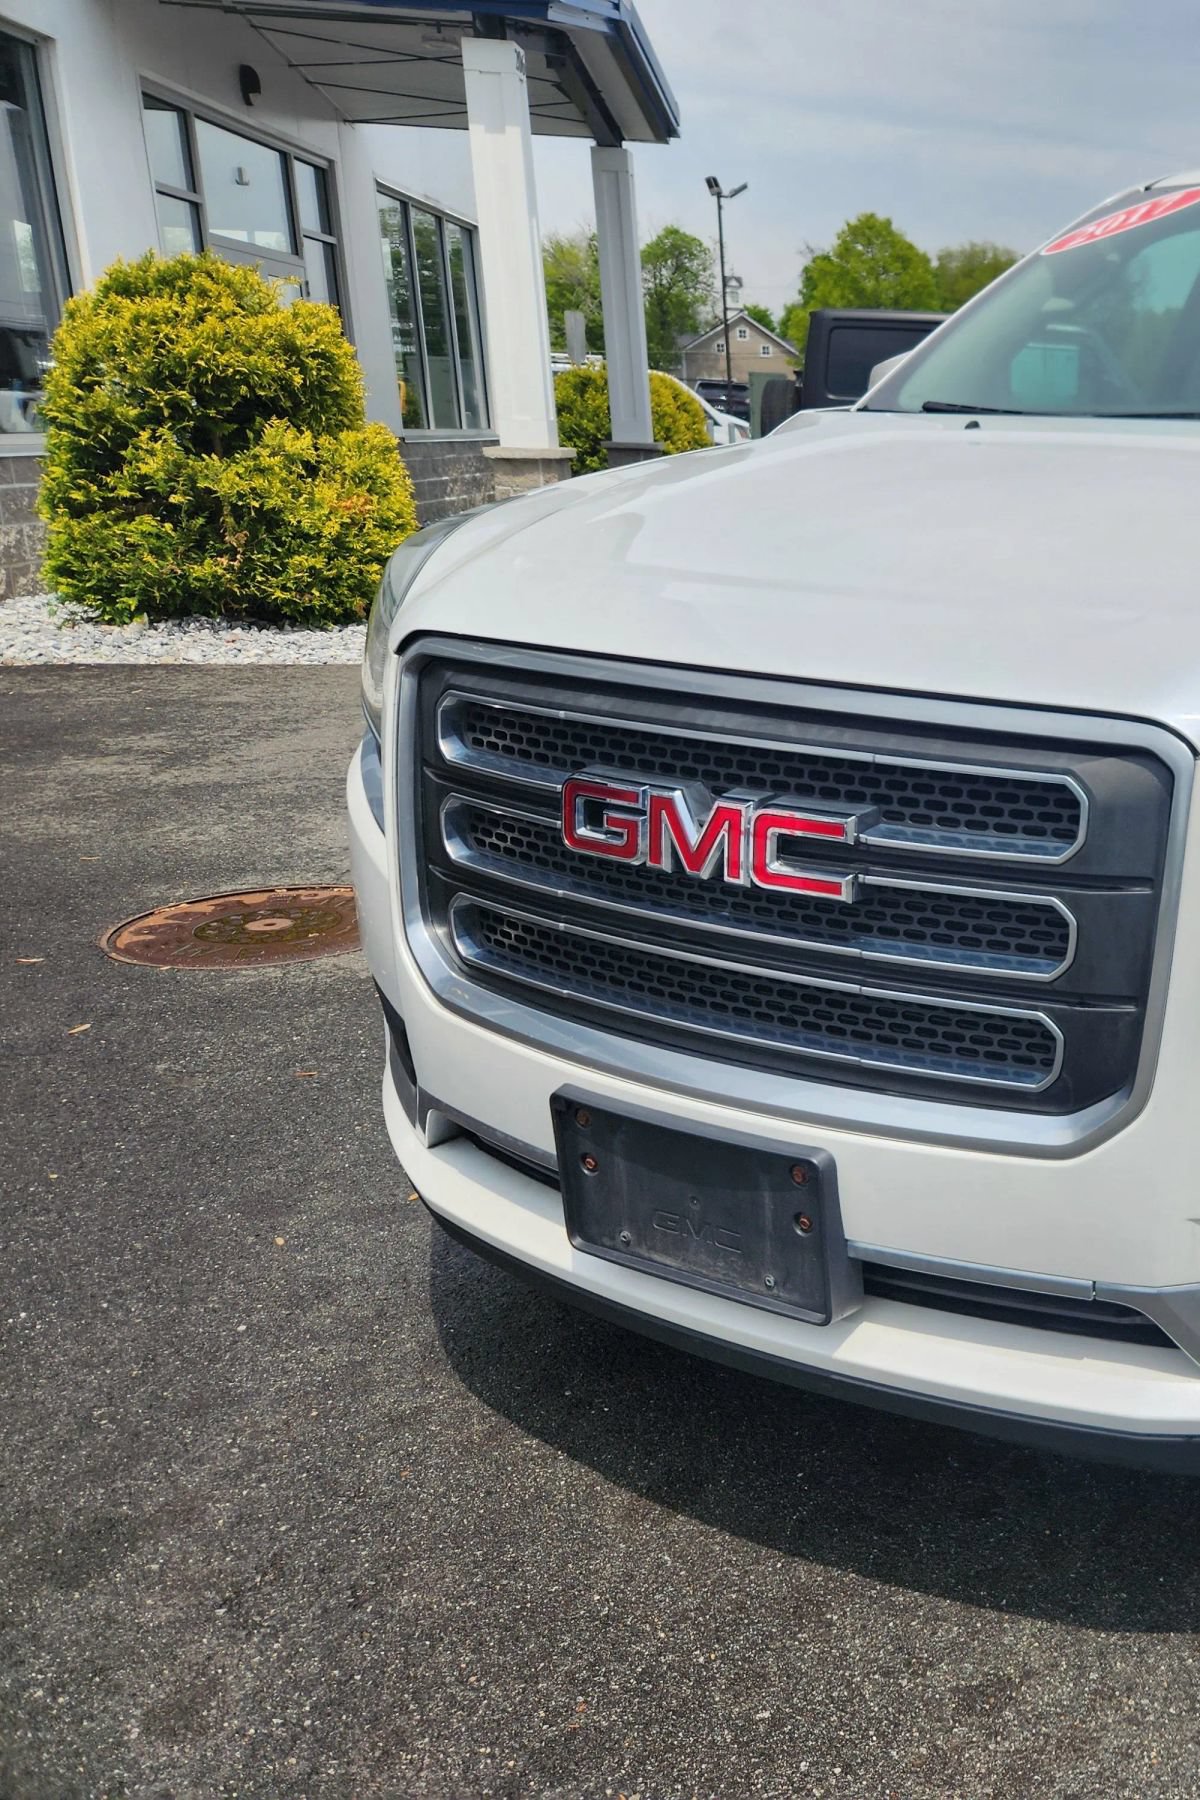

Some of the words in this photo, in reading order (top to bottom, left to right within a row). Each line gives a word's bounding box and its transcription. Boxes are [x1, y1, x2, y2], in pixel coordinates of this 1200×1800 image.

[1067, 190, 1187, 248] 2017
[562, 771, 858, 904] GMC
[652, 1209, 743, 1254] GMC
